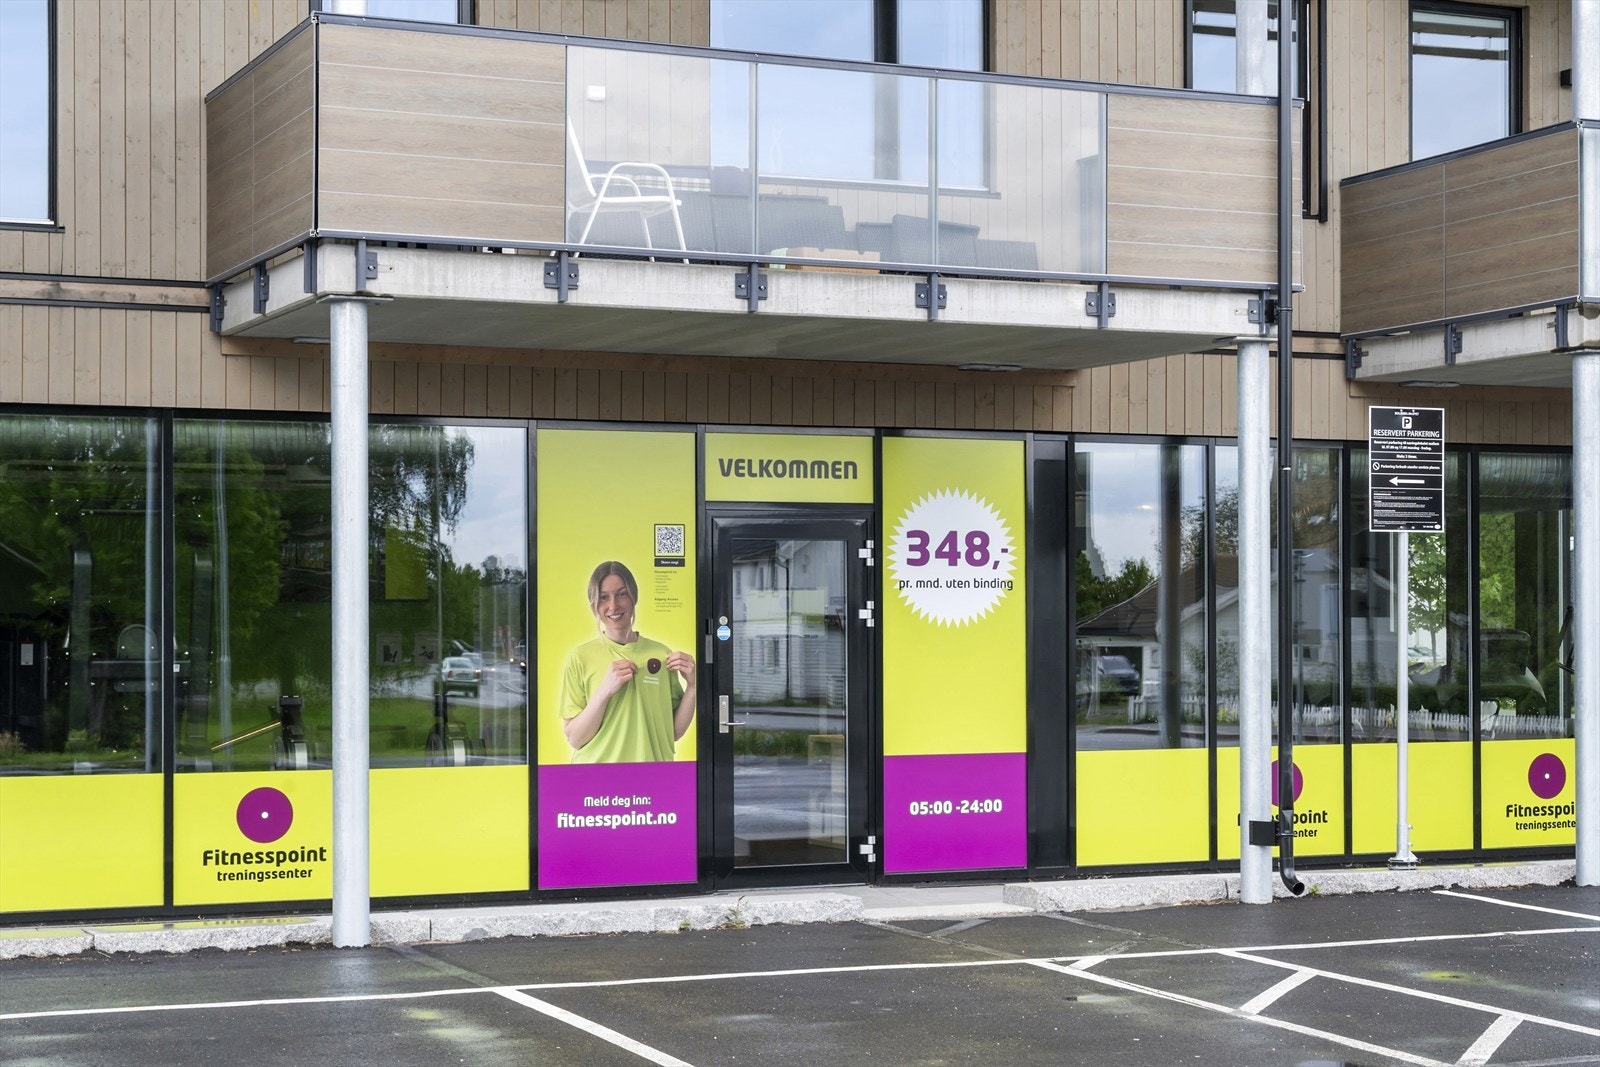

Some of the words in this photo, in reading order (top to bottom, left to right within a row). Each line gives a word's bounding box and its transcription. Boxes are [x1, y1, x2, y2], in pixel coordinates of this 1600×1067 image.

[1373, 429, 1406, 437] RESERVERT
[1407, 430, 1440, 438] PARKERING
[718, 458, 858, 479] VELKOMMEN
[906, 529, 1009, 570] 348,-
[899, 579, 913, 591] pr.
[916, 578, 943, 589] mnd.
[946, 578, 971, 589] uten
[973, 577, 1014, 591] binding
[584, 796, 610, 807] Meld
[611, 795, 631, 807] deg
[632, 795, 651, 805] inn:
[909, 800, 953, 816] 05:00
[1506, 801, 1575, 819] Fitnesspoi
[557, 810, 677, 829] fitnesspoint.no
[1515, 819, 1576, 831] treningssente
[202, 846, 327, 867] Fitnesspoint
[217, 868, 312, 882] treningssenter
